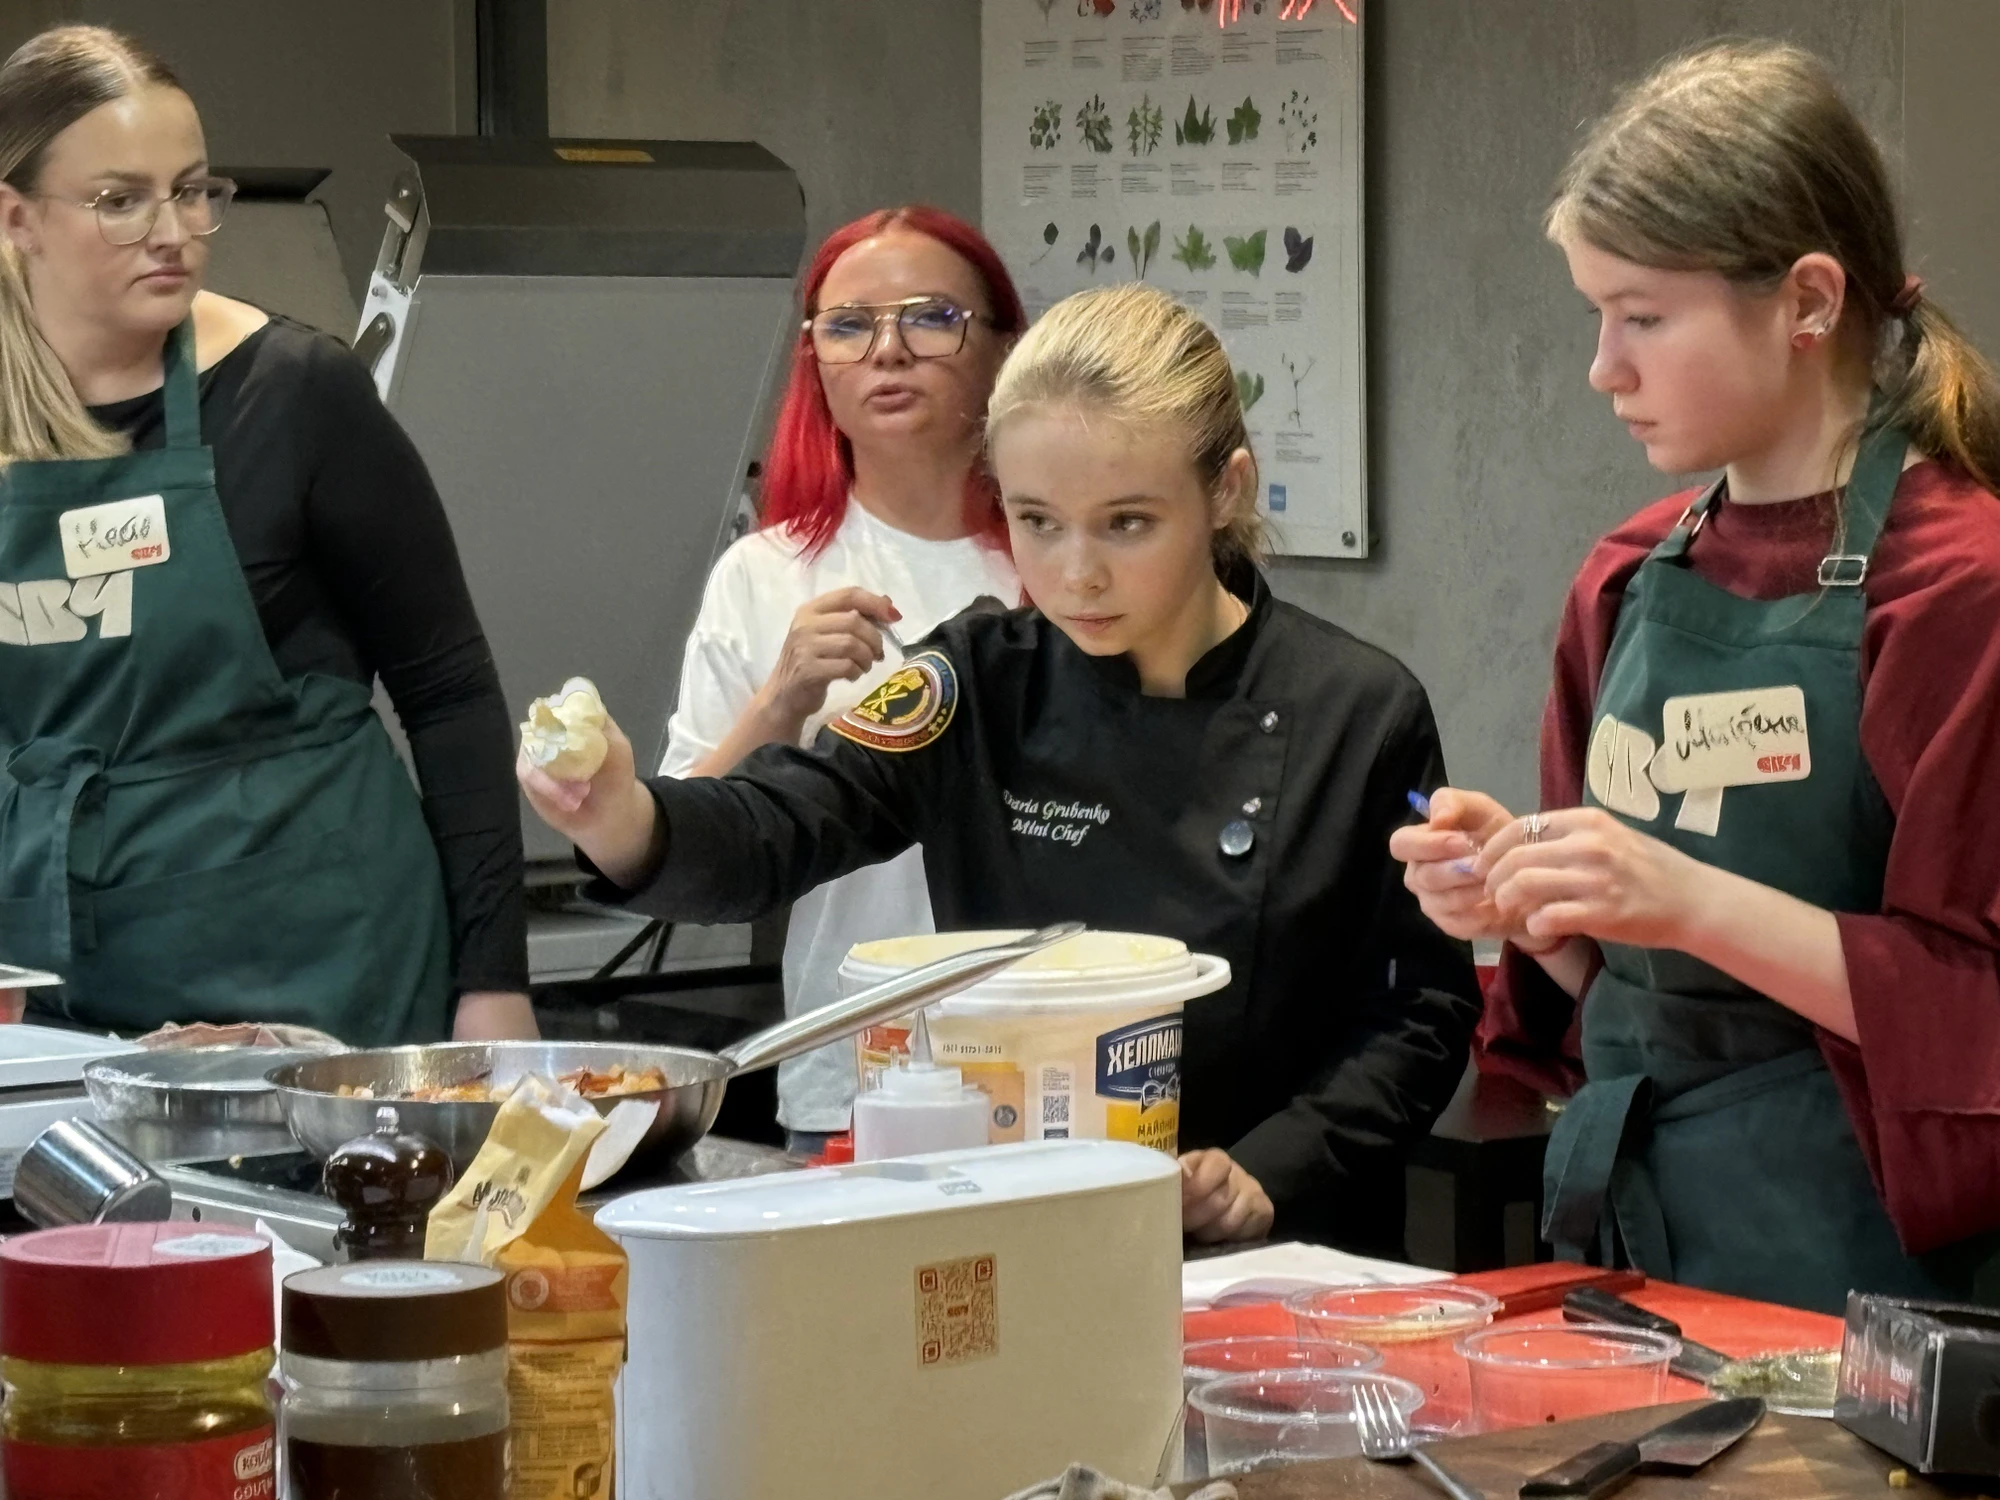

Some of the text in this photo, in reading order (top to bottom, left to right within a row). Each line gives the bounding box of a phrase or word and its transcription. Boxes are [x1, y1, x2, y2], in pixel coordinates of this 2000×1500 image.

[1042, 800, 1111, 825] Grubenko
[1011, 817, 1091, 847] Mini Chef
[1106, 1027, 1183, 1077] ХЕЛЛМАН
